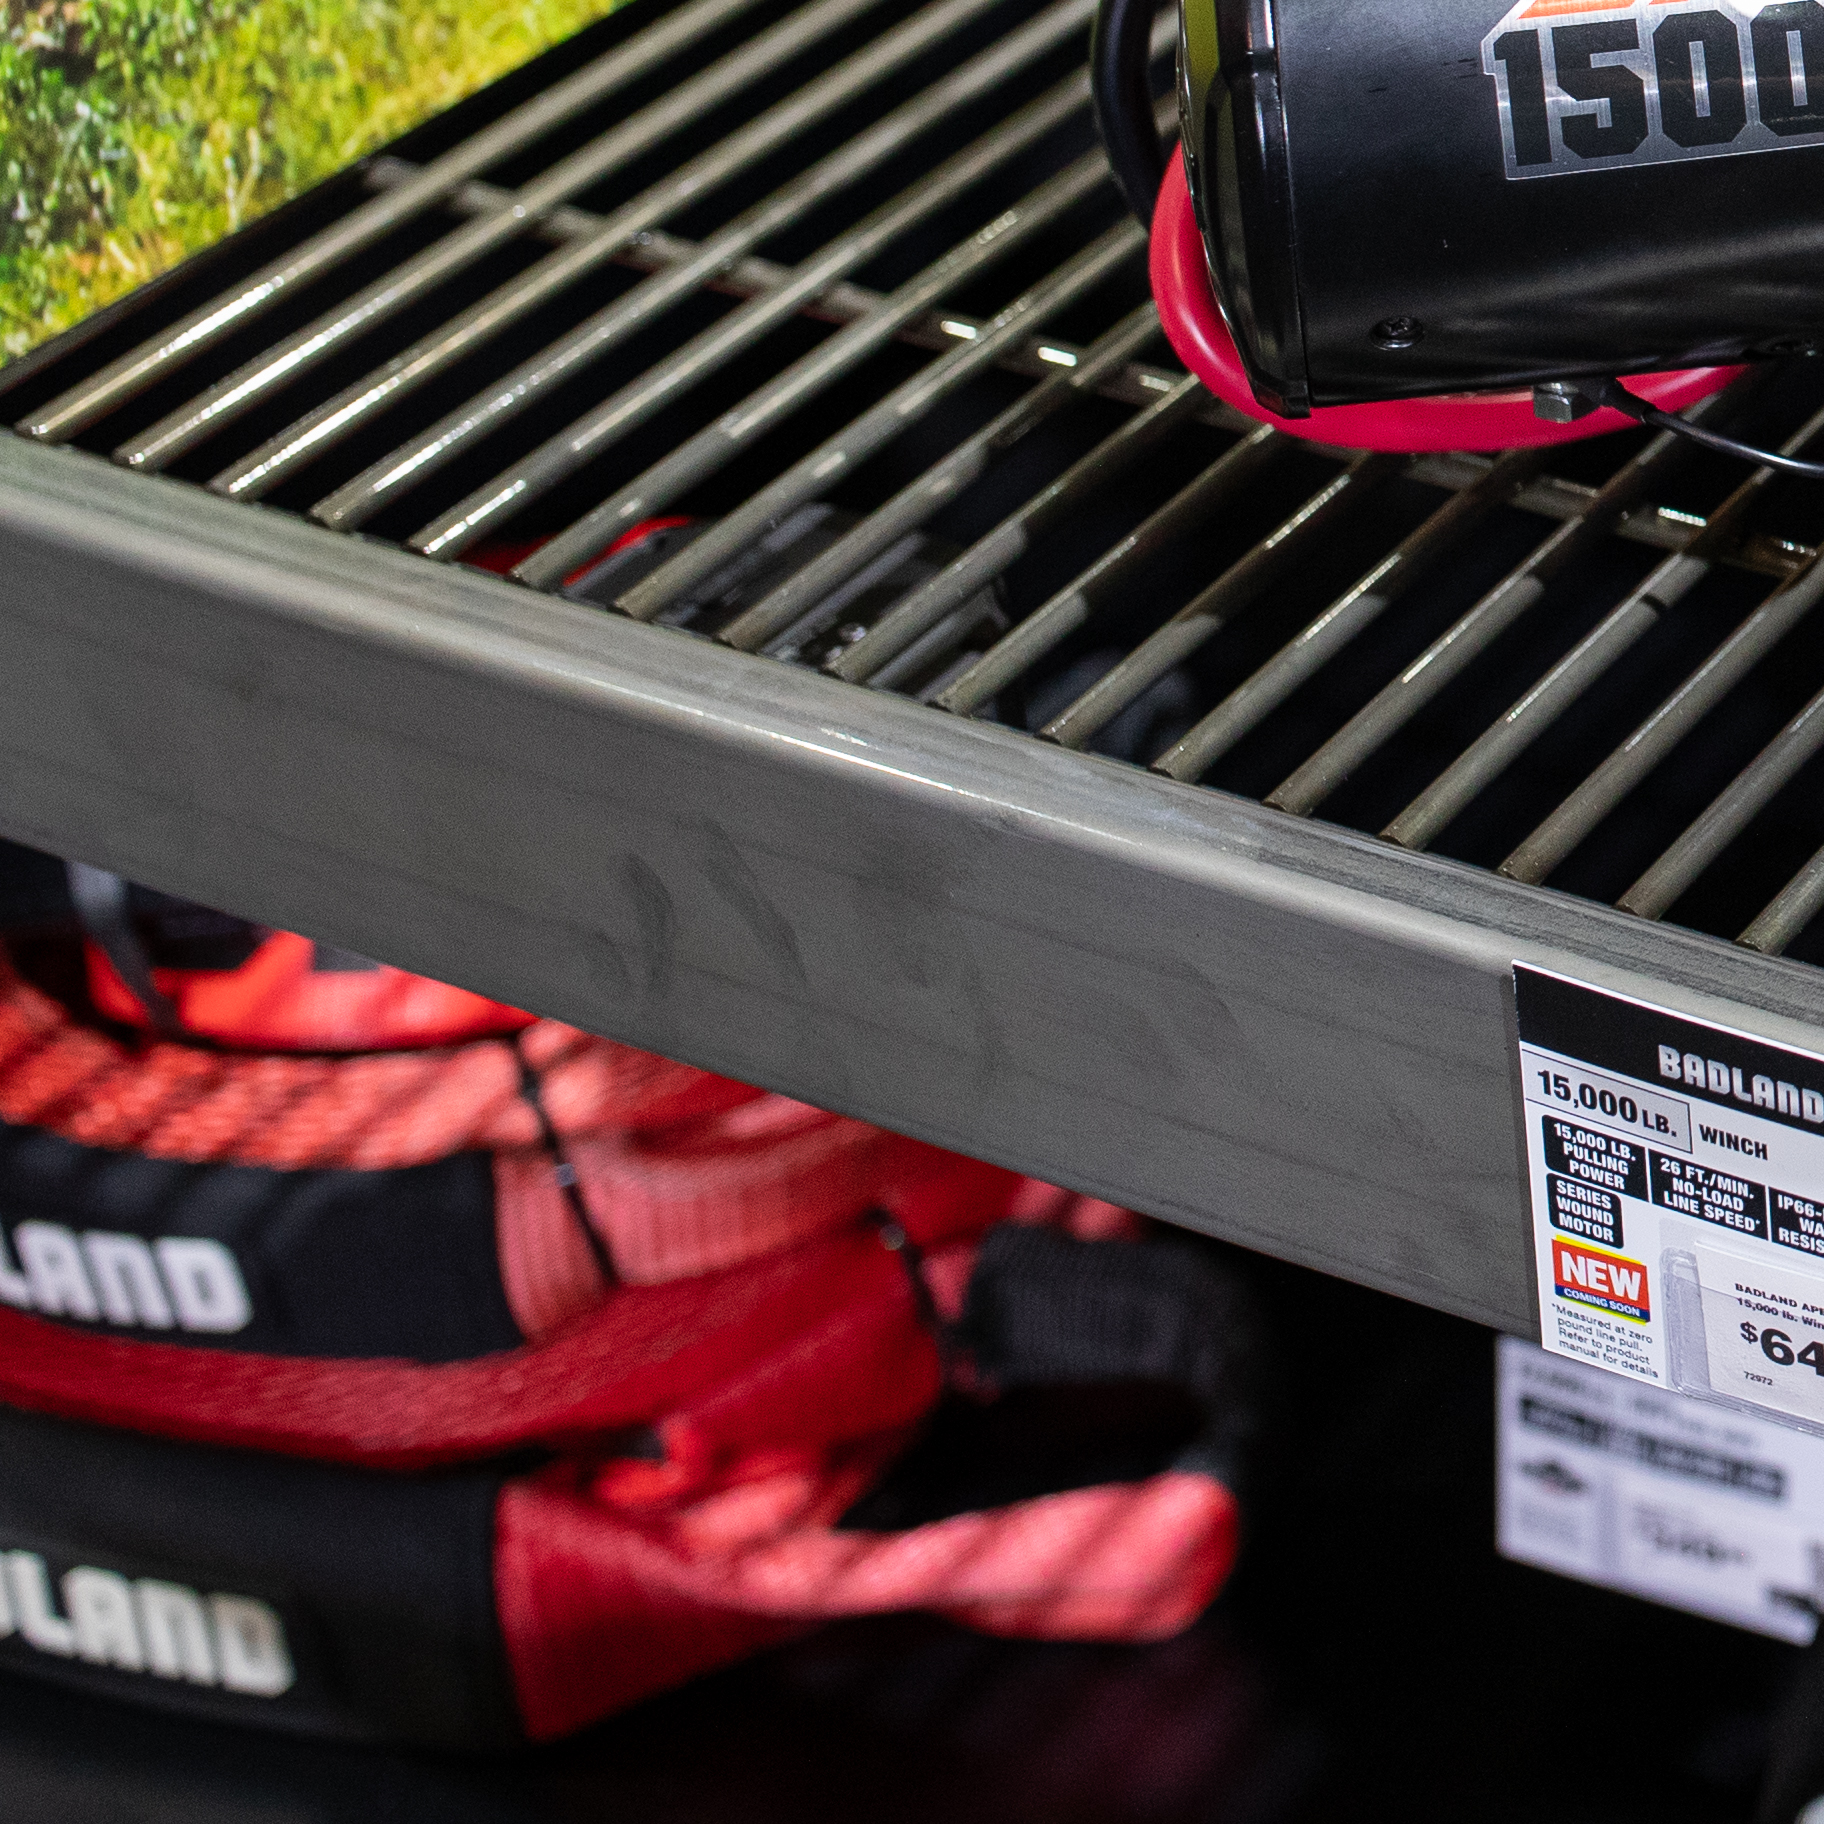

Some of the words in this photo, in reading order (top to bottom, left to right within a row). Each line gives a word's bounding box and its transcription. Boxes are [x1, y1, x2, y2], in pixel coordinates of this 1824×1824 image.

[1658, 1044, 1824, 1124] BADLAND
[1537, 1069, 1639, 1124] 15,000
[1642, 1109, 1678, 1138] LB.
[1553, 1122, 1607, 1151] 15,000
[1610, 1140, 1637, 1162] LB.
[1562, 1141, 1630, 1175] PULLING
[1699, 1124, 1769, 1161] WINCH
[1569, 1159, 1626, 1191] POWER
[1660, 1157, 1682, 1176] 26
[1685, 1164, 1755, 1200] FT./MIN.
[1556, 1179, 1612, 1210] SERIES
[1556, 1196, 1614, 1227] WOUND
[1663, 1190, 1700, 1215] LINE
[1672, 1177, 1744, 1212] NO-LOAD
[1558, 1213, 1614, 1243] MOTOR
[1560, 1249, 1642, 1302] NEW
[1563, 1287, 1608, 1308] COMING
[1608, 1299, 1641, 1317] SOON
[1734, 1282, 1798, 1308] BADLAND
[1737, 1297, 1779, 1316] 15,000
[1782, 1309, 1798, 1323] lb.
[1557, 1317, 1593, 1337] pound
[1596, 1327, 1616, 1342] line
[1619, 1336, 1644, 1353] pull.
[1559, 1327, 1589, 1345] Refer
[1591, 1337, 1602, 1348] to
[1605, 1341, 1651, 1365] product
[1615, 1324, 1626, 1335] at
[1628, 1329, 1654, 1345] zero
[1559, 1339, 1600, 1359] manual
[1602, 1350, 1618, 1364] for
[1621, 1358, 1659, 1379] details
